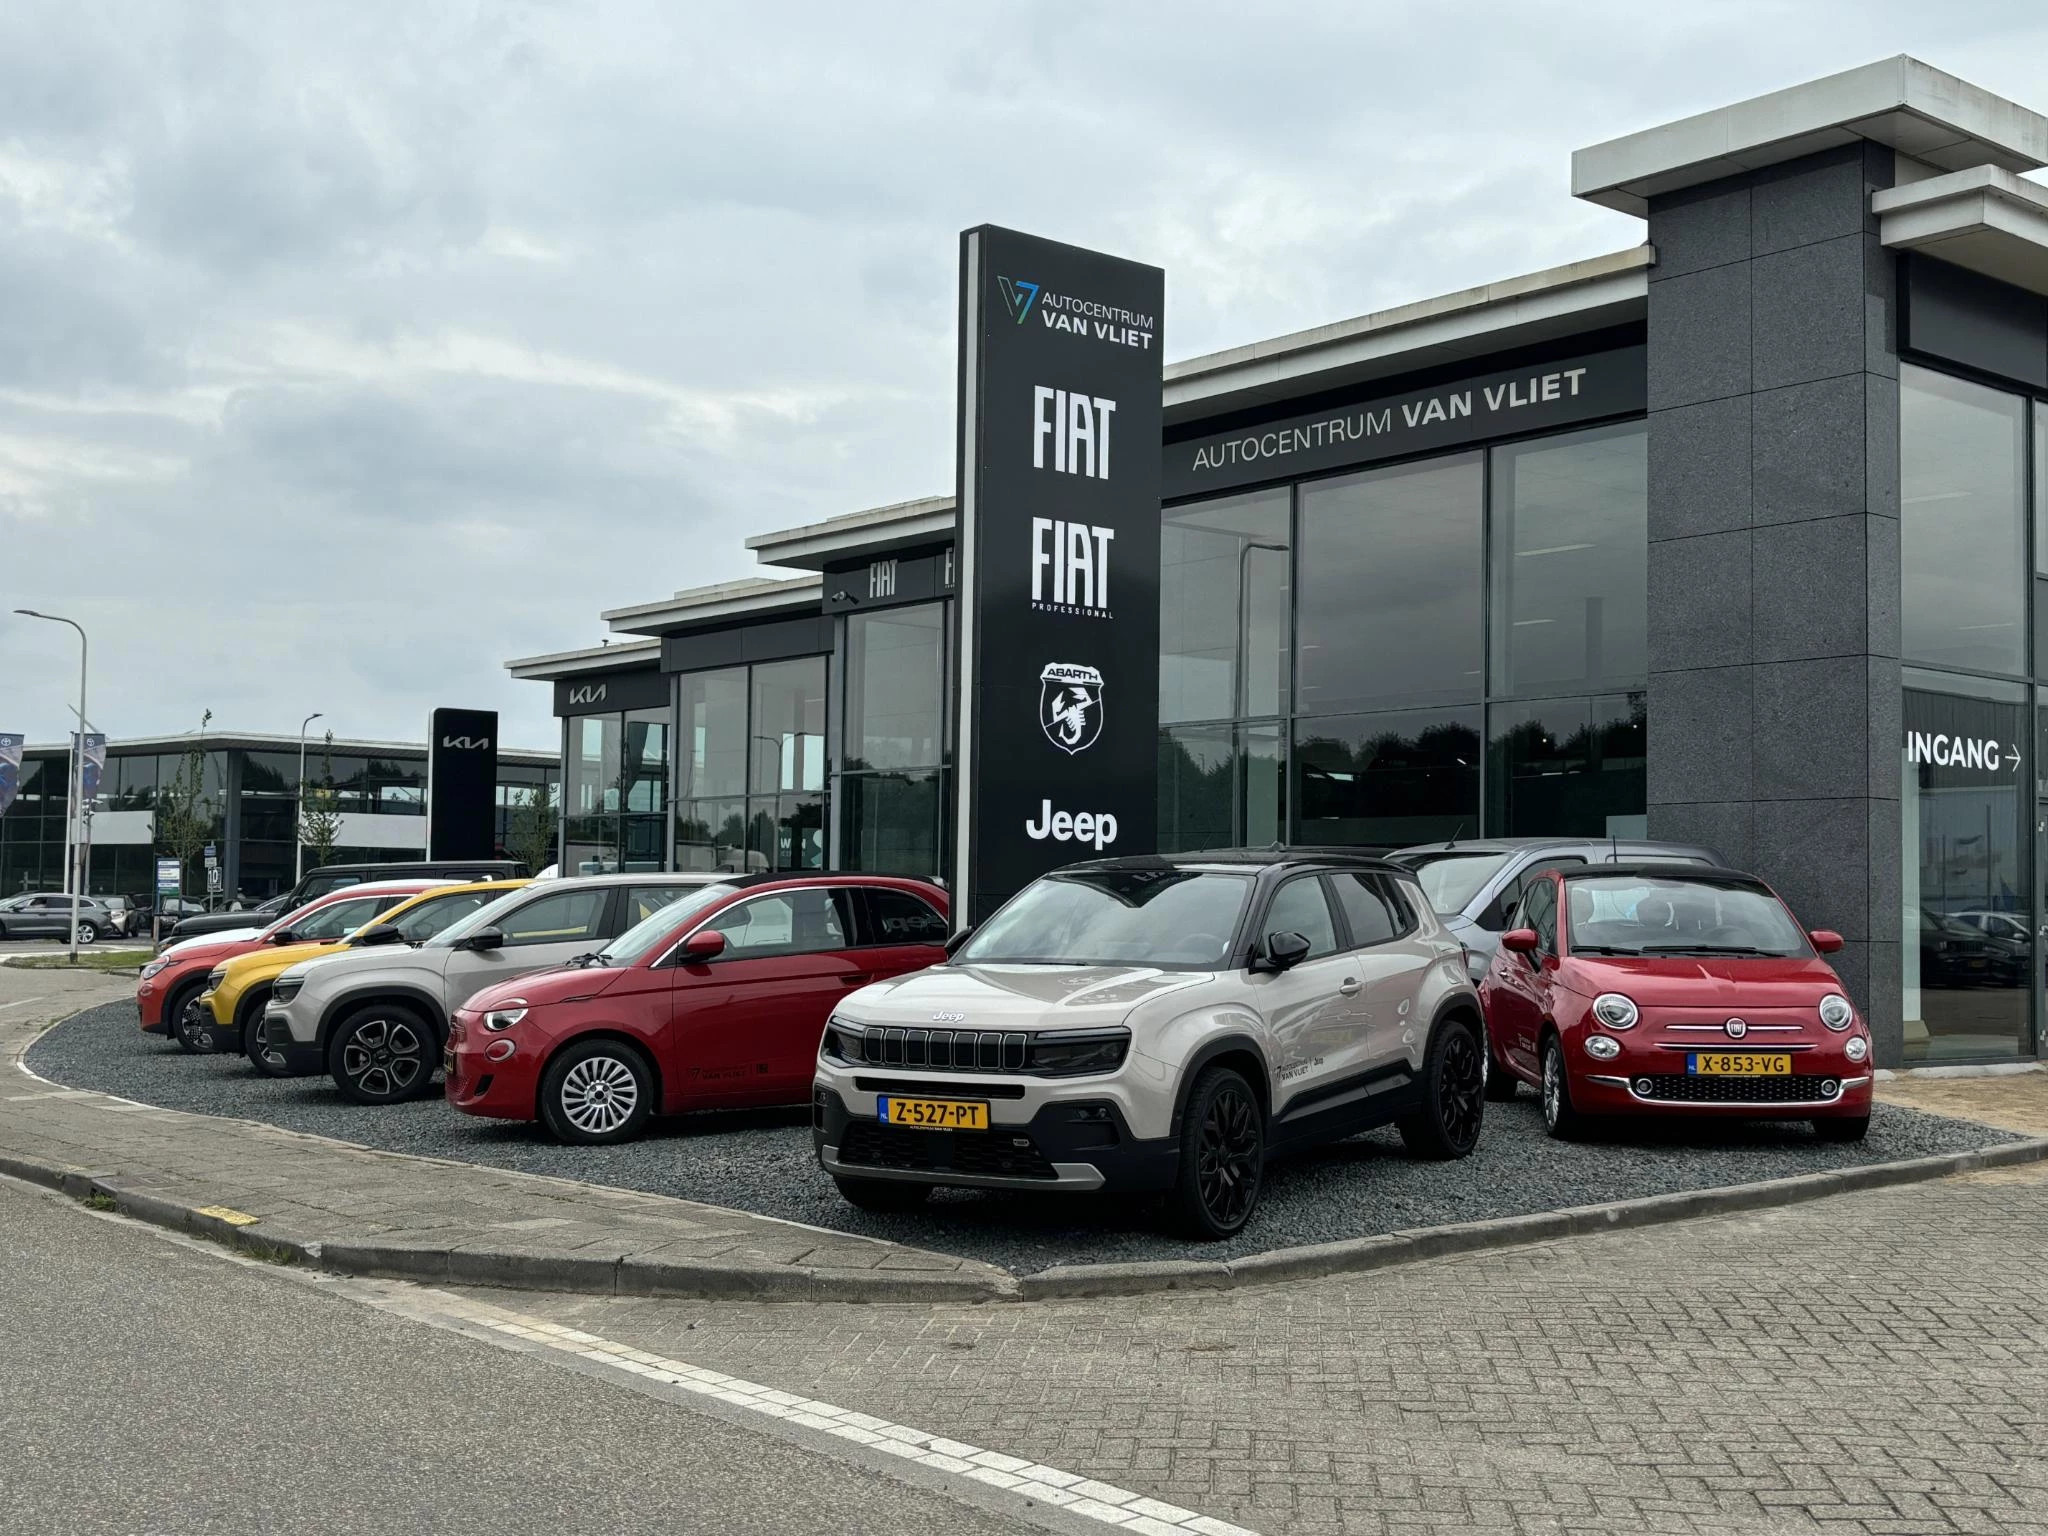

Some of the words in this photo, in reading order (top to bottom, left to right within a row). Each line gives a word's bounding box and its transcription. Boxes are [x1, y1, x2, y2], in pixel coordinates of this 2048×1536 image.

[1042, 292, 1154, 329] AUTOCENTRUM
[1041, 309, 1087, 336] VAN
[1093, 321, 1153, 350] VLIET
[1033, 385, 1117, 480] FIAT
[1192, 408, 1391, 471] AUTOCENTRUM
[1401, 390, 1472, 428] VAN
[1482, 367, 1587, 412] VLIET
[869, 559, 898, 599] FIAT
[1031, 516, 1115, 609] FIAT
[1031, 602, 1114, 620] PROFESSIONAL
[1046, 668, 1099, 682] ABARTH
[569, 683, 607, 705] KIA
[442, 735, 489, 750] KIA
[1907, 730, 2000, 771] INGANG
[1026, 799, 1118, 851] Jeep
[932, 1010, 965, 1023] Jeep
[1702, 1056, 1784, 1073] X-853-VG
[896, 1101, 979, 1126] Z-527-PT
